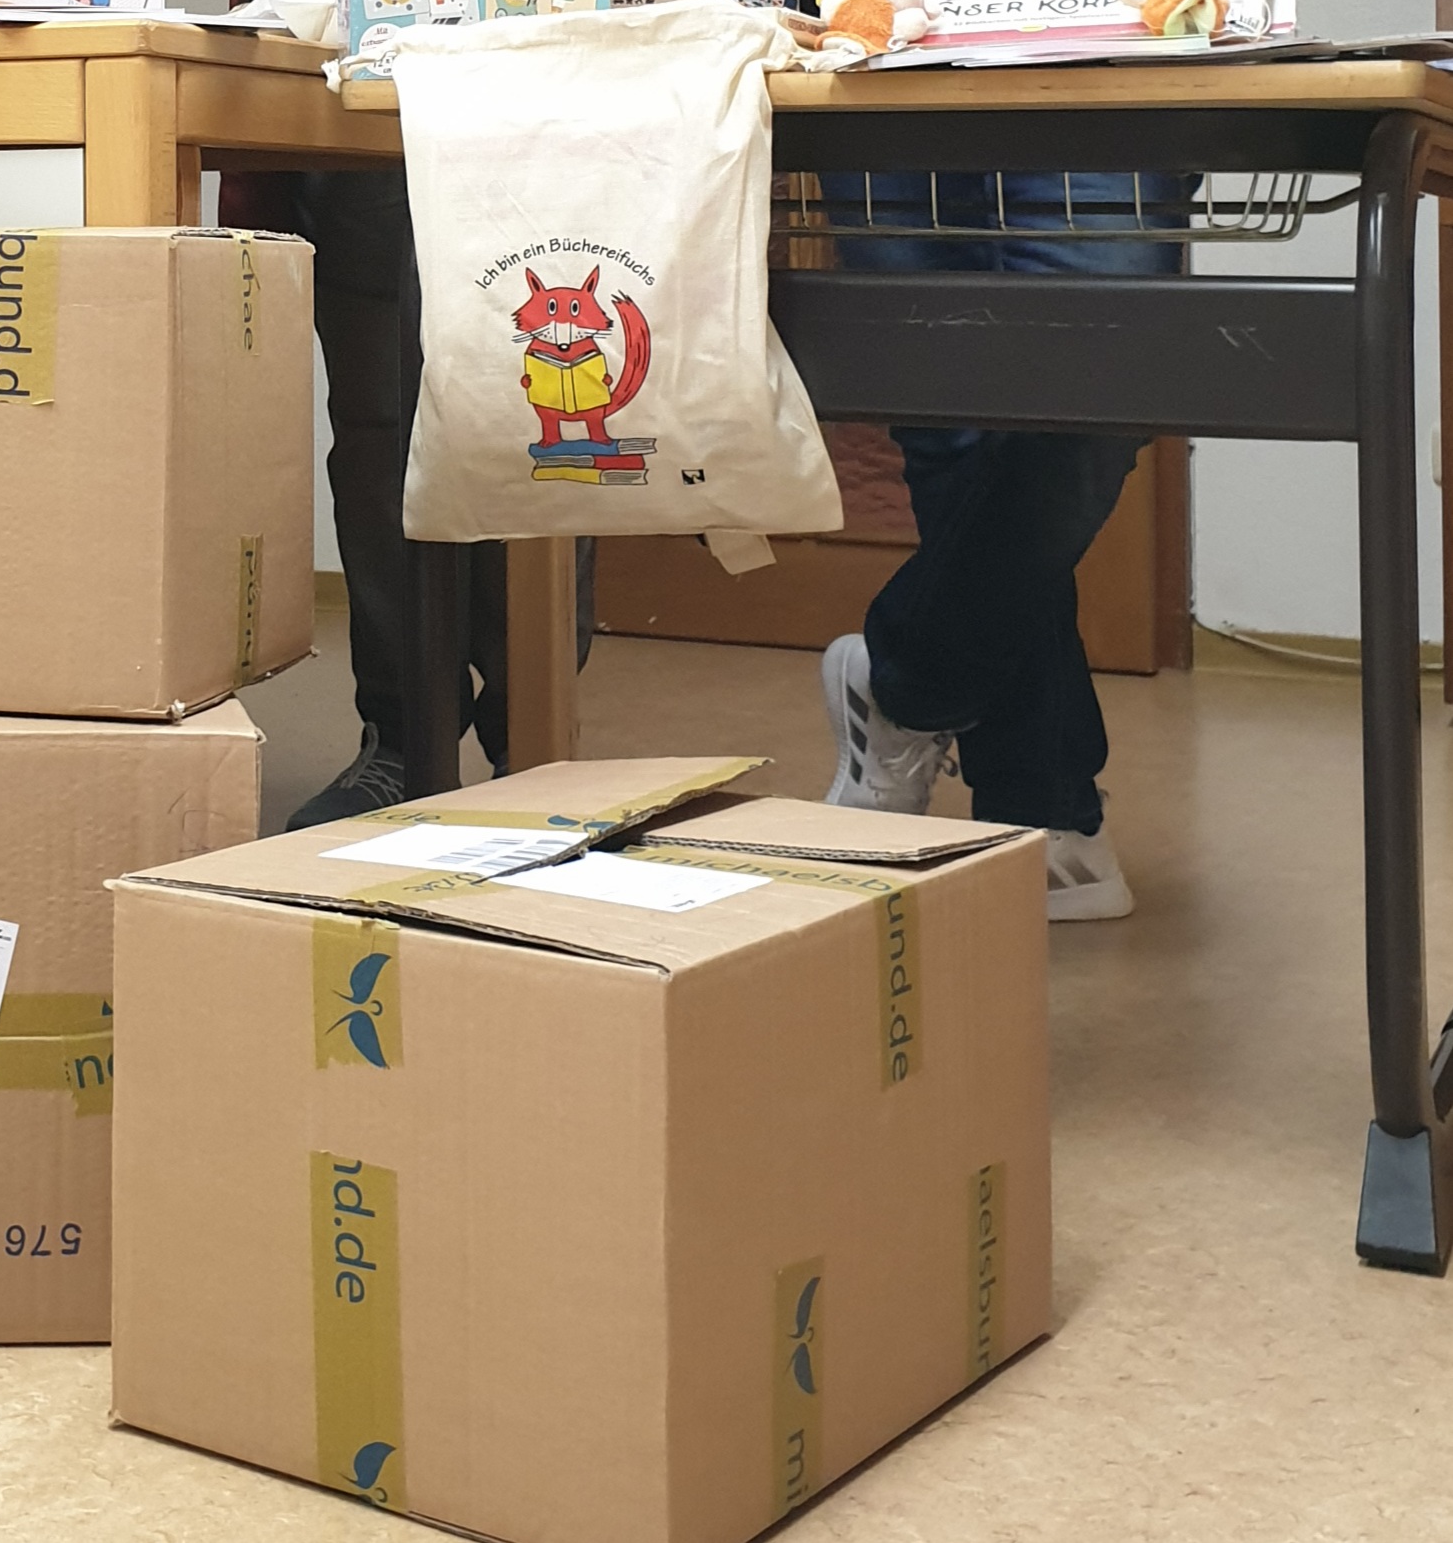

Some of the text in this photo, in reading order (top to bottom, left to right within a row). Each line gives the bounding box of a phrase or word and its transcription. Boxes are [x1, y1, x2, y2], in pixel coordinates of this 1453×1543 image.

[474, 238, 656, 290] Ich bin ein Büchereifuchs
[887, 892, 913, 1082] und.de
[4, 1222, 83, 1257] 576
